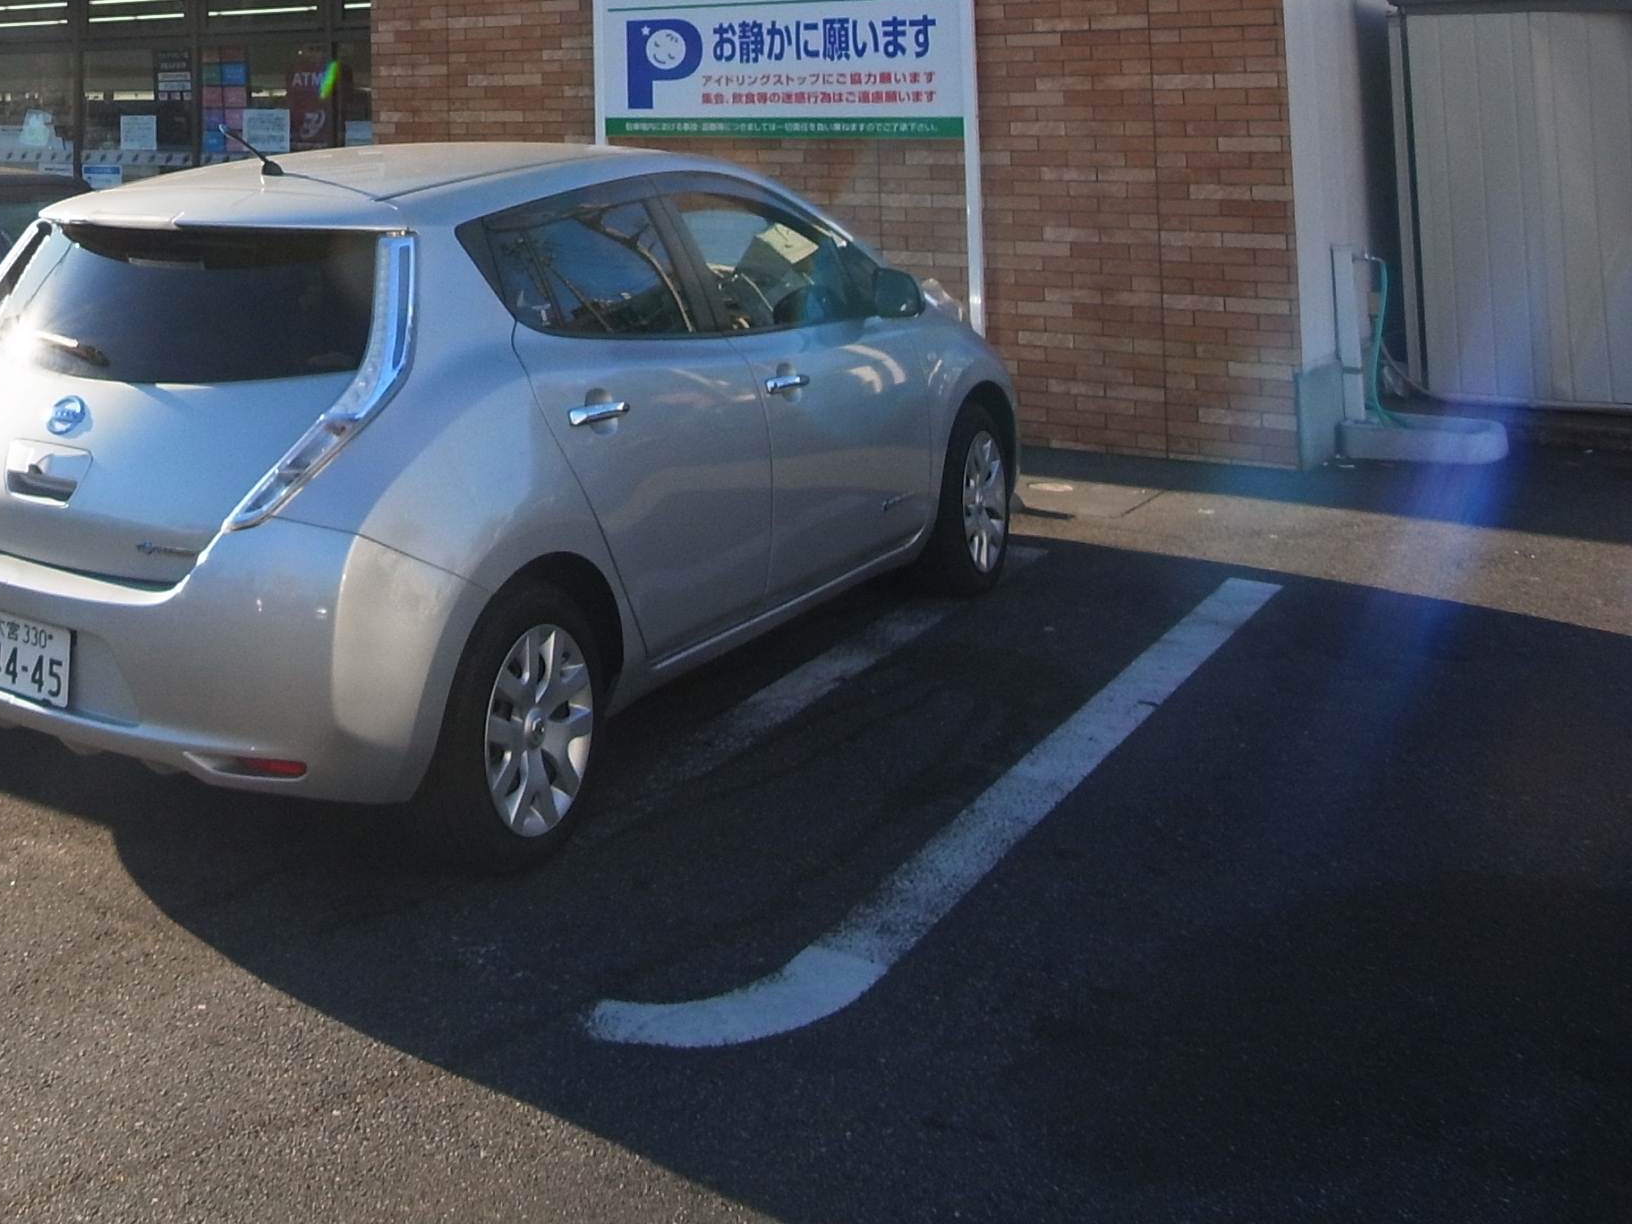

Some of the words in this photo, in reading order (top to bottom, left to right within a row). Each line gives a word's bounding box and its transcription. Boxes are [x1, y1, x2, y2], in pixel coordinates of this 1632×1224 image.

[712, 15, 936, 64] お静かに願います
[292, 72, 324, 87] ATM
[701, 70, 936, 88] アイドリングストップにご協力願います
[22, 624, 47, 649] 330
